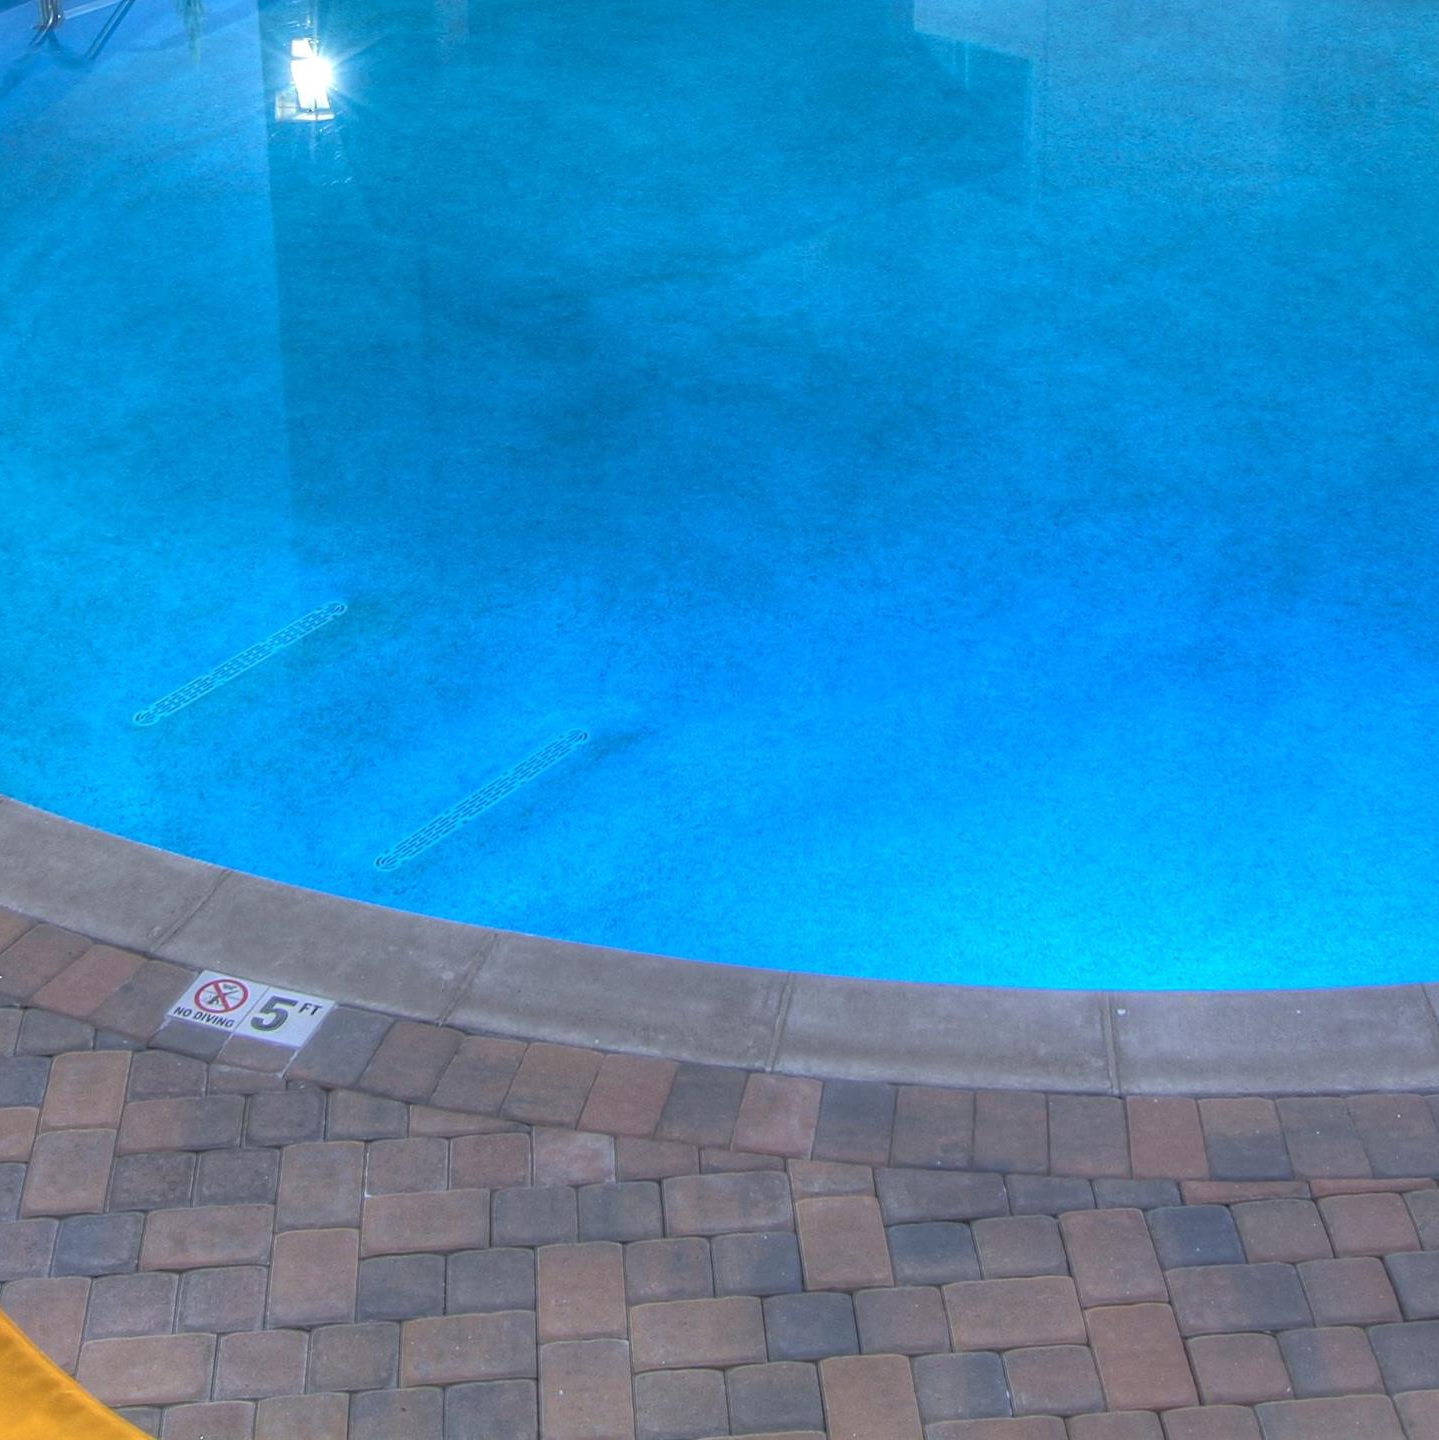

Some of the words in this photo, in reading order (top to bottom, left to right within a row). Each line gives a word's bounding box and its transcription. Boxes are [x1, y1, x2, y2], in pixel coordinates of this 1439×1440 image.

[173, 1006, 190, 1018] NO
[193, 1011, 236, 1029] DIVING
[250, 994, 299, 1033] 5
[298, 1002, 323, 1017] FT
